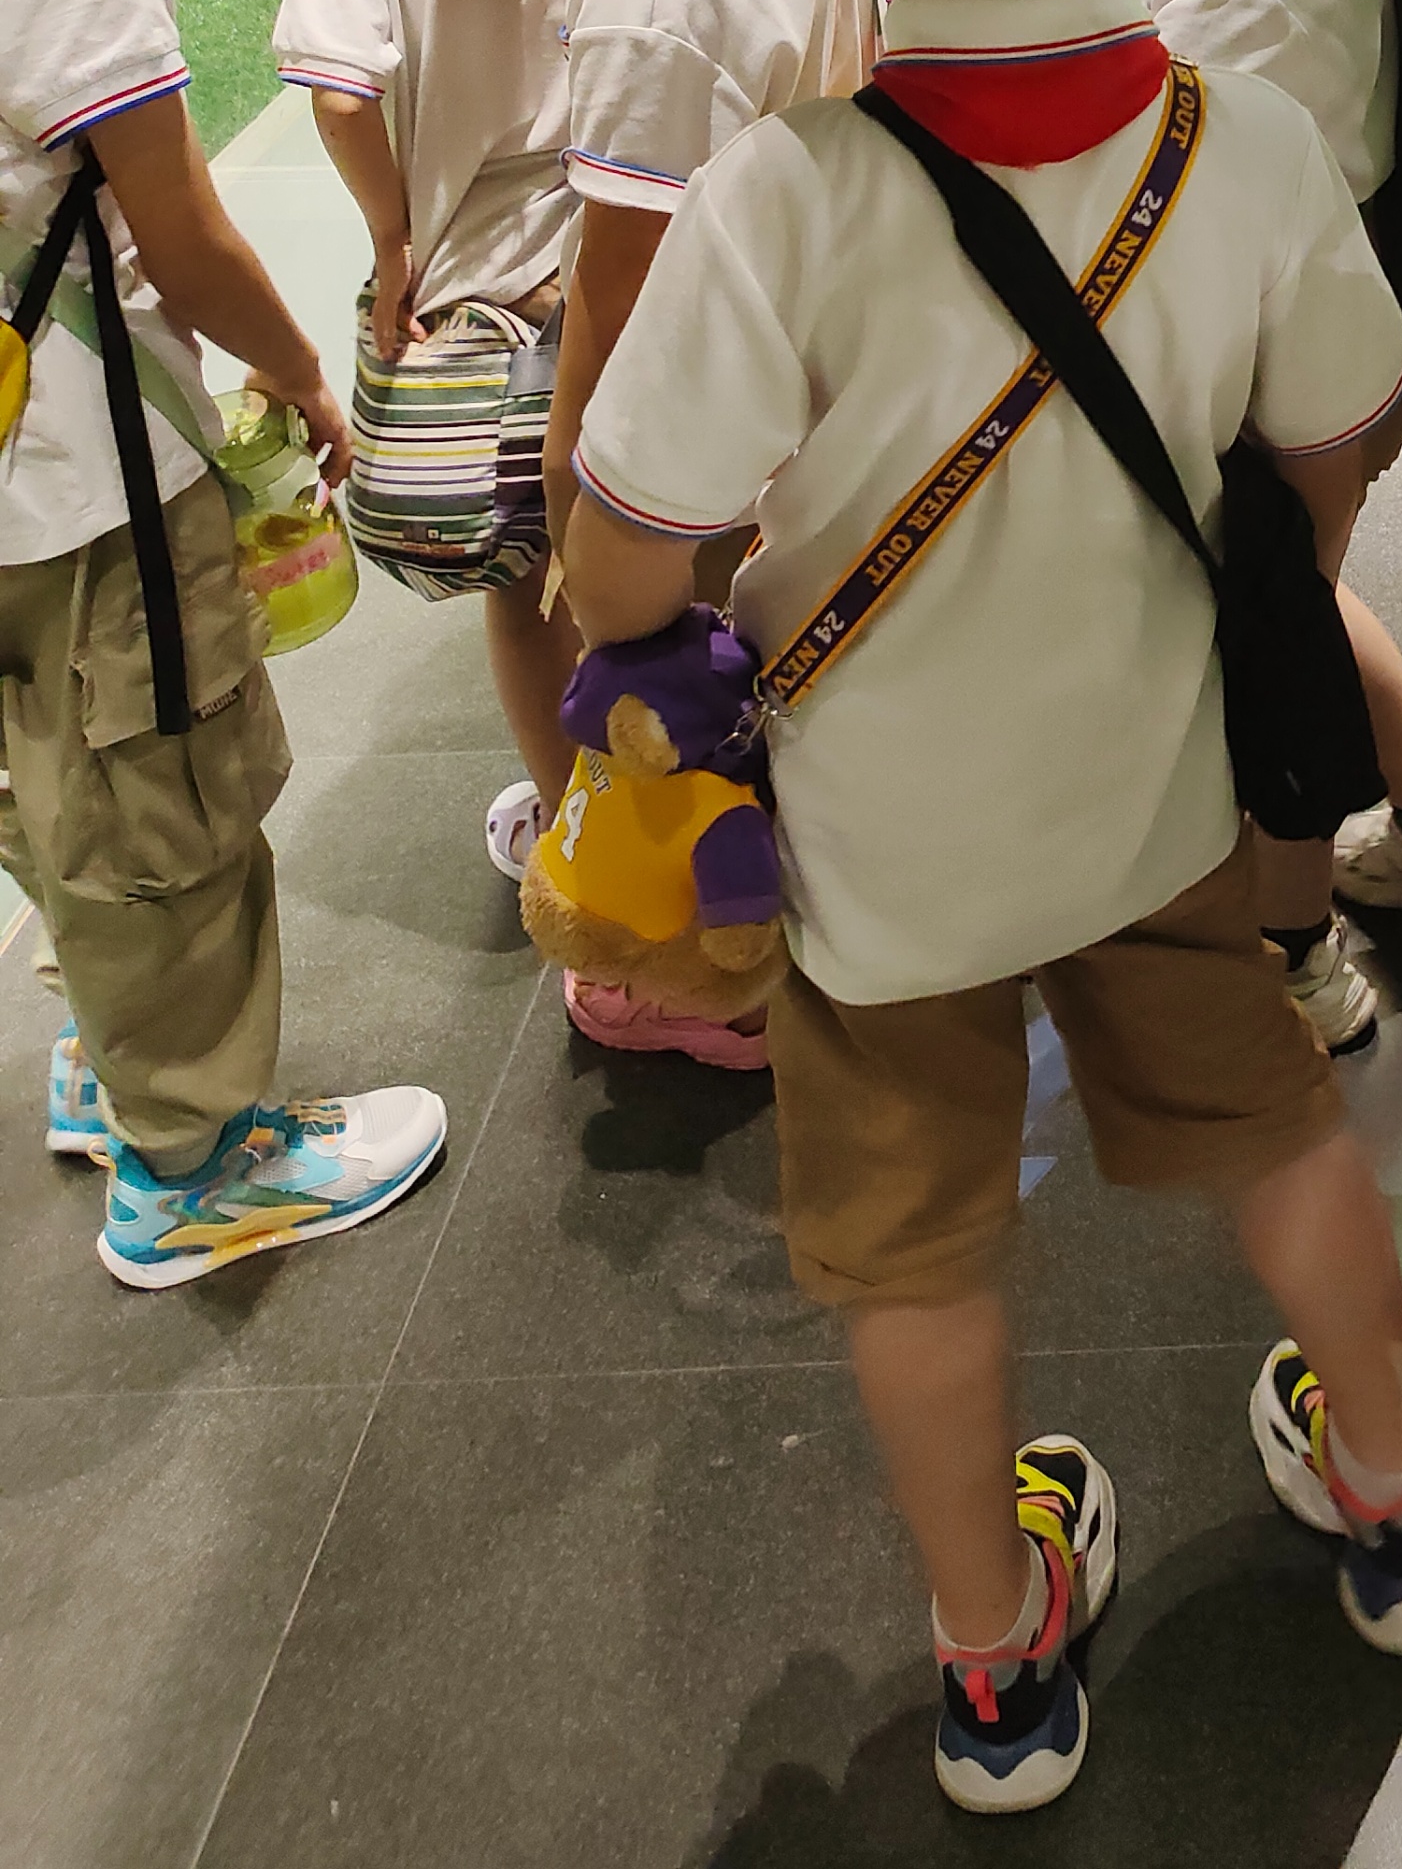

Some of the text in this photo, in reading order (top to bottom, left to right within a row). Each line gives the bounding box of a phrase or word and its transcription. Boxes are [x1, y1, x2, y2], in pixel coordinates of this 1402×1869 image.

[1170, 90, 1196, 150] OUT
[1132, 189, 1163, 227] 24
[976, 419, 1010, 450] 24
[906, 450, 985, 531] NEVER
[865, 533, 913, 587] OUT
[813, 610, 845, 644] 24
